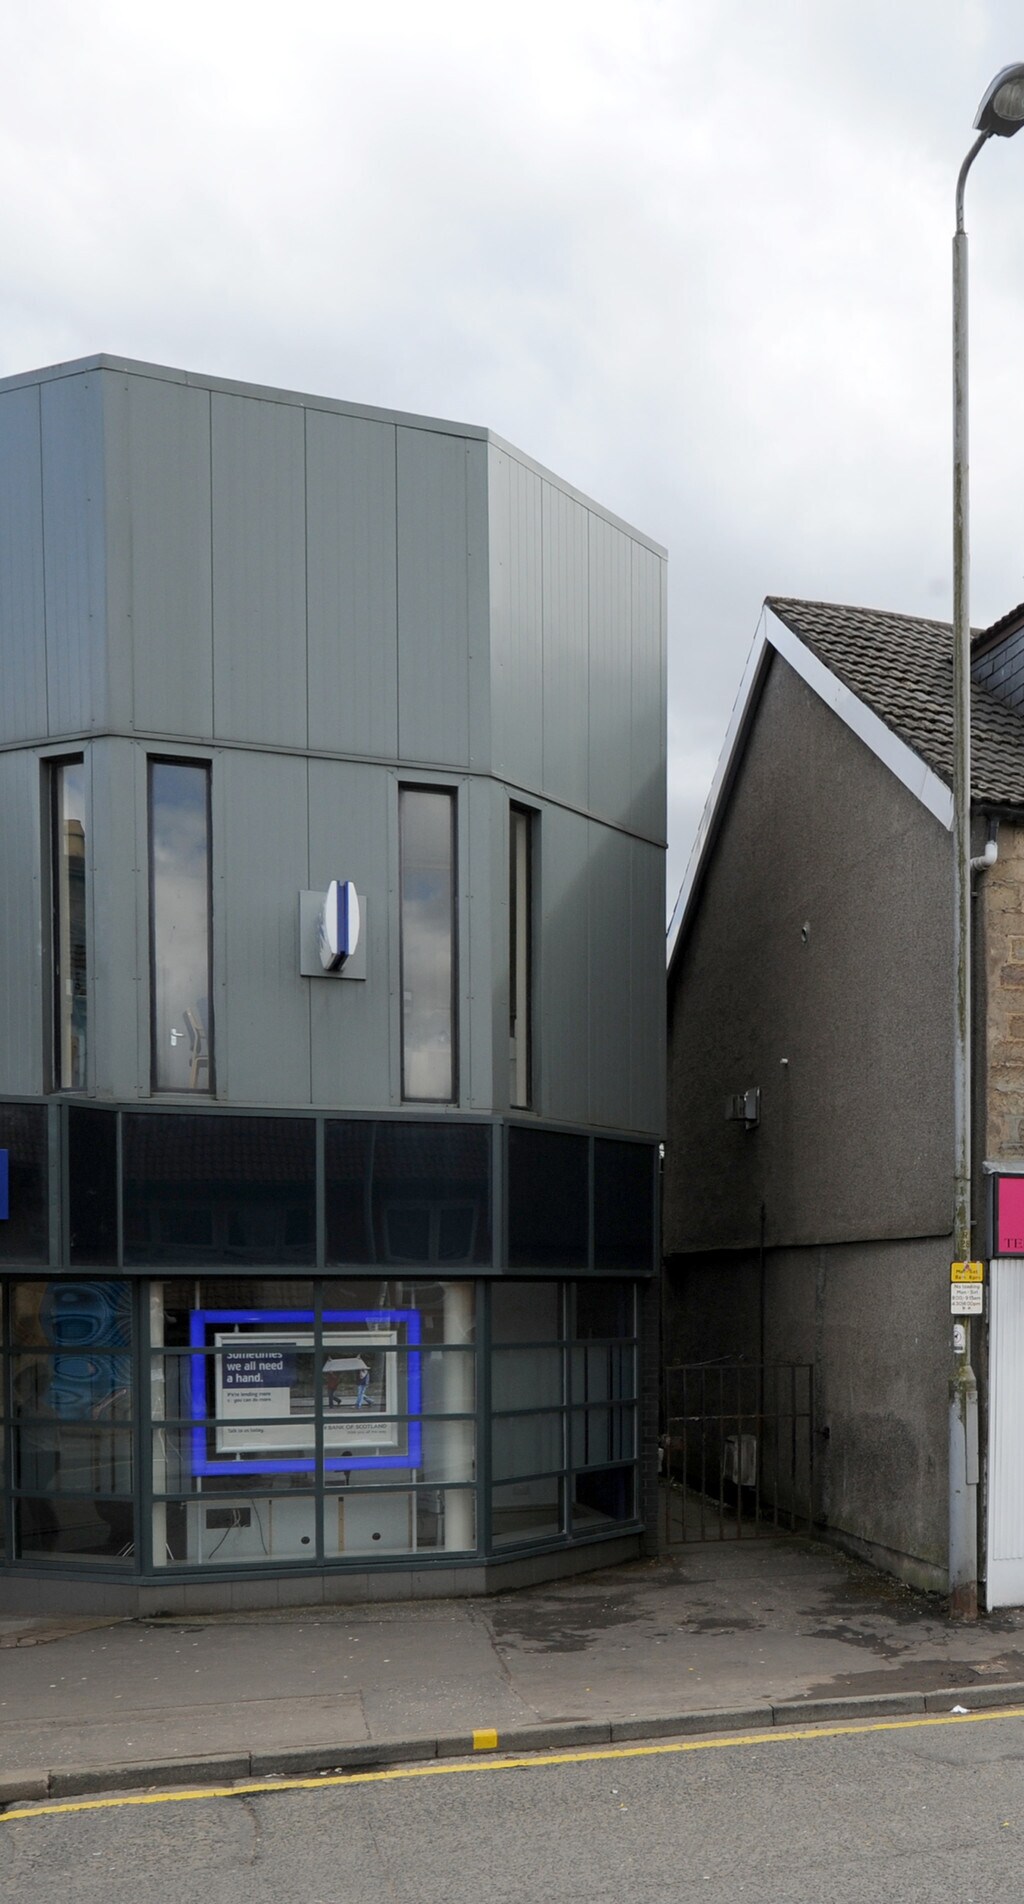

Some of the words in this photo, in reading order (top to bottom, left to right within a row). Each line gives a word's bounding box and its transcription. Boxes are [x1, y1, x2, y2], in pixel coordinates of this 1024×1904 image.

[226, 1363, 242, 1371] we
[244, 1361, 257, 1371] all
[259, 1360, 284, 1371] need
[226, 1375, 233, 1383] a
[235, 1372, 264, 1383] hand.
